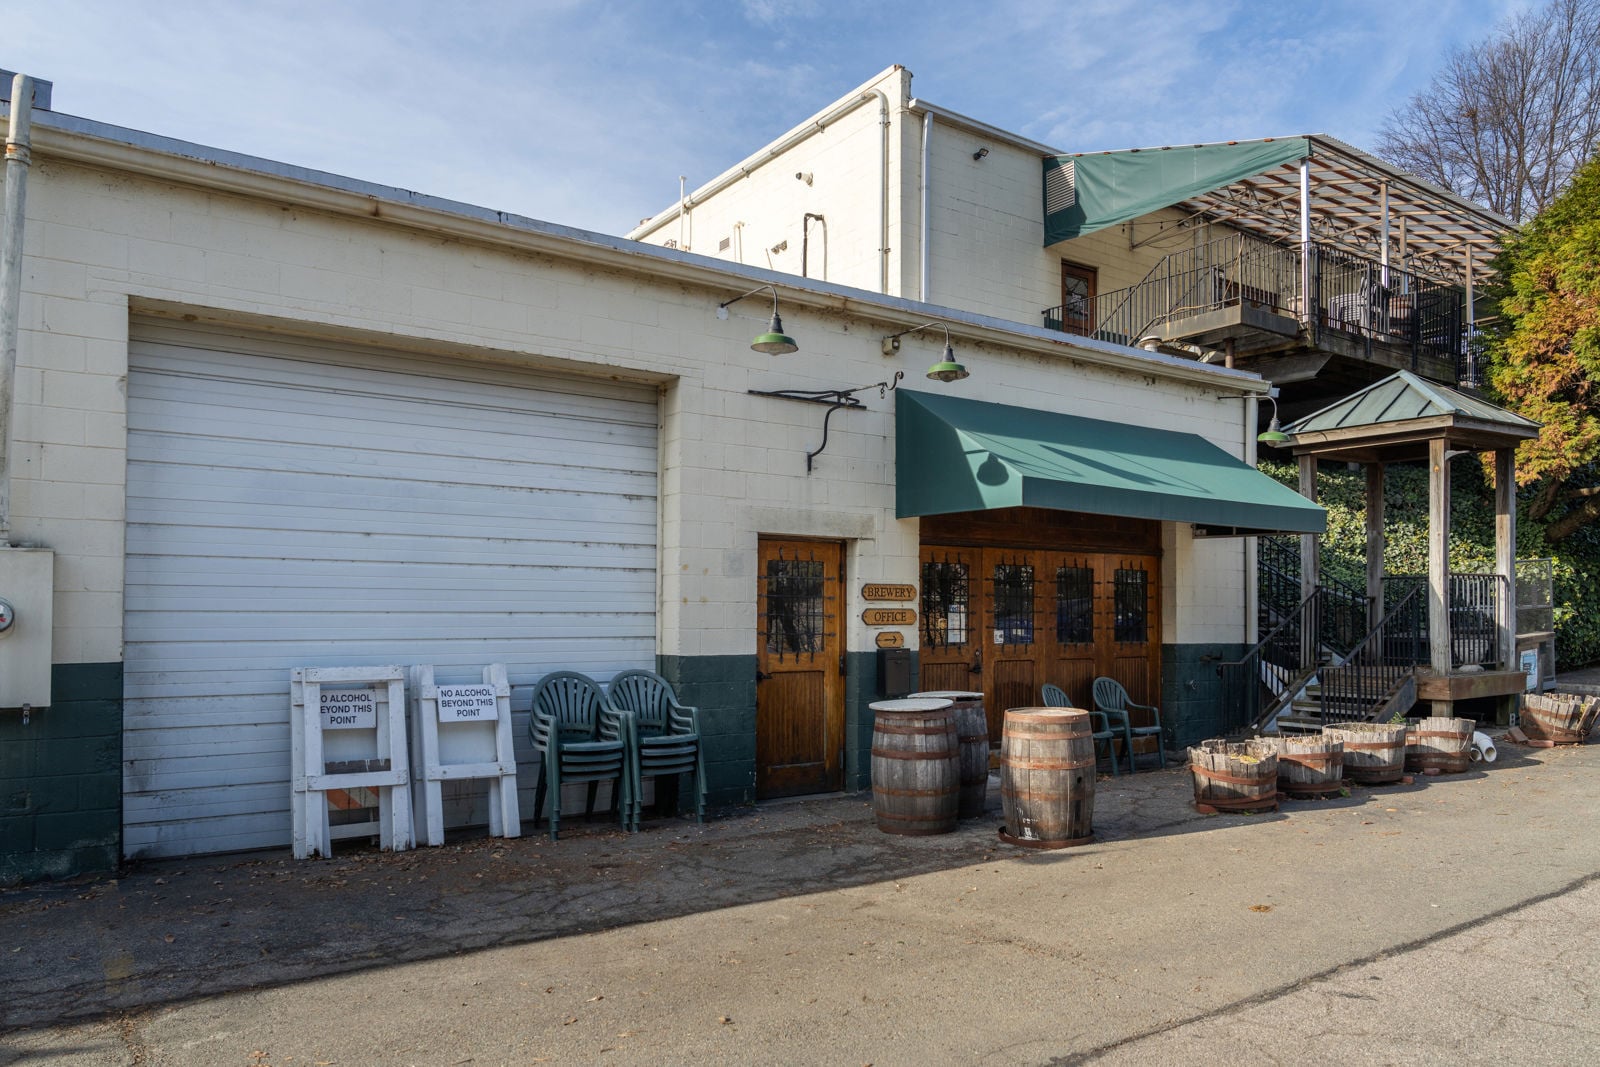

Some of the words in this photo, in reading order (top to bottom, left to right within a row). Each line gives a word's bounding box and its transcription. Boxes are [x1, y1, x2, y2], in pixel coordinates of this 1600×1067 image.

[867, 587, 913, 597] BREWERY
[874, 612, 907, 621] OFFICE
[455, 689, 492, 697] ALCOHOL
[320, 694, 327, 703] O
[330, 694, 372, 702] ALCOHOL
[442, 699, 474, 707] BEYOND
[475, 698, 493, 706] THIS
[320, 705, 350, 713] EYOND
[352, 704, 372, 712] THIS
[456, 709, 480, 717] POINT
[330, 716, 357, 724] POINT
